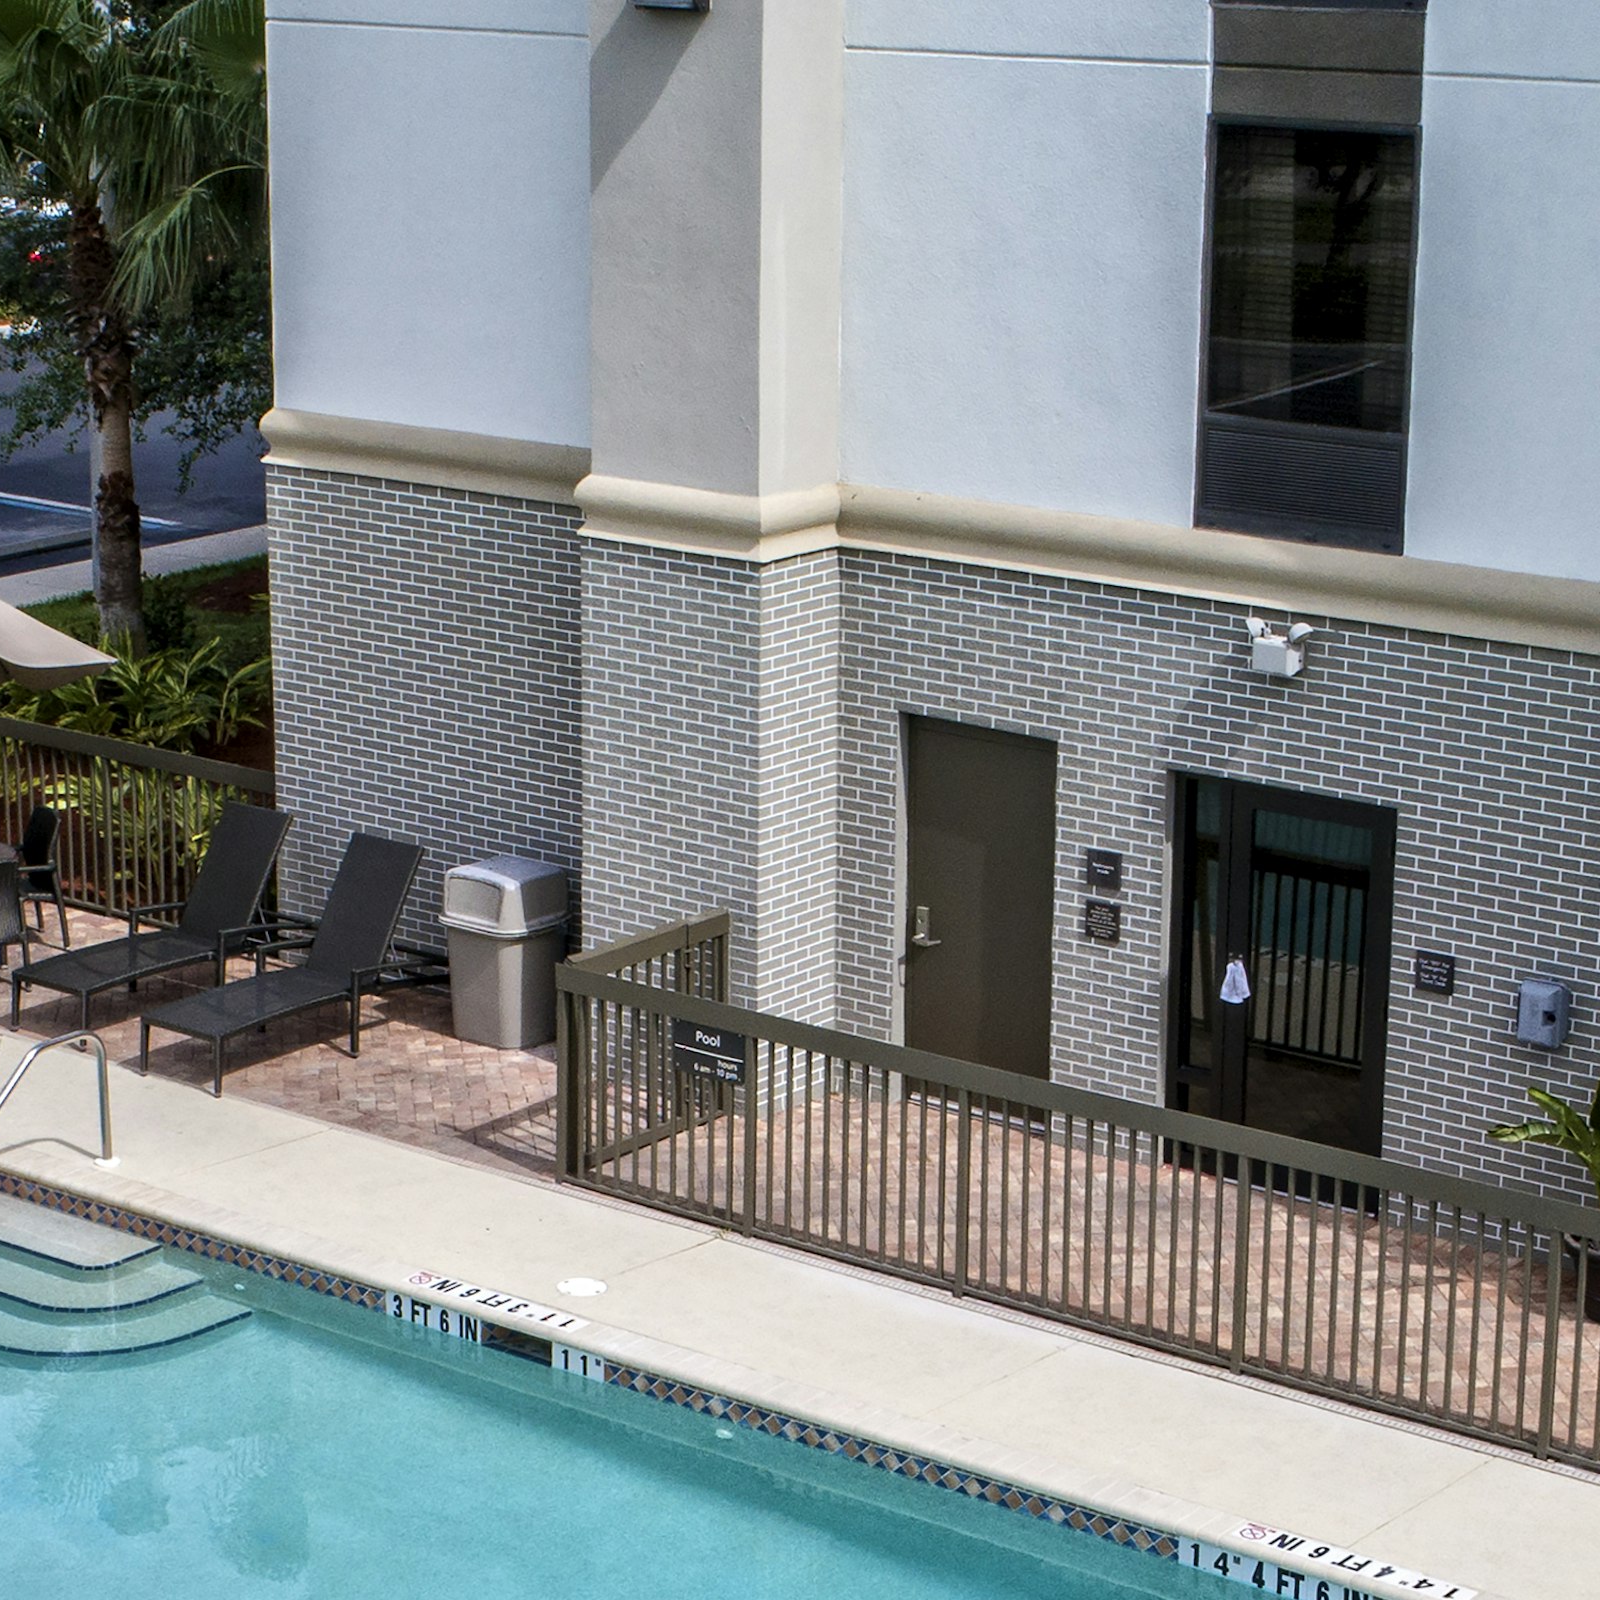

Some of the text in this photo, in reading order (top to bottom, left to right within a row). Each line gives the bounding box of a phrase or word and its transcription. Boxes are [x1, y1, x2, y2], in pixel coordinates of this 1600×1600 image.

[695, 1030, 721, 1047] Pool
[693, 1062, 699, 1071] 6
[716, 1068, 725, 1077] 10
[717, 1059, 739, 1072] hours
[430, 1278, 459, 1294] IN
[459, 1287, 478, 1299] 6
[476, 1291, 512, 1308] FT
[507, 1303, 529, 1315] 3
[393, 1295, 478, 1342] 3 FT 6 IN
[1268, 1532, 1302, 1552] IN
[1308, 1545, 1330, 1559] 6
[1331, 1553, 1372, 1572] FT
[1373, 1565, 1395, 1579] 4
[1251, 1561, 1265, 1589] 4
[1276, 1567, 1305, 1600] FT
